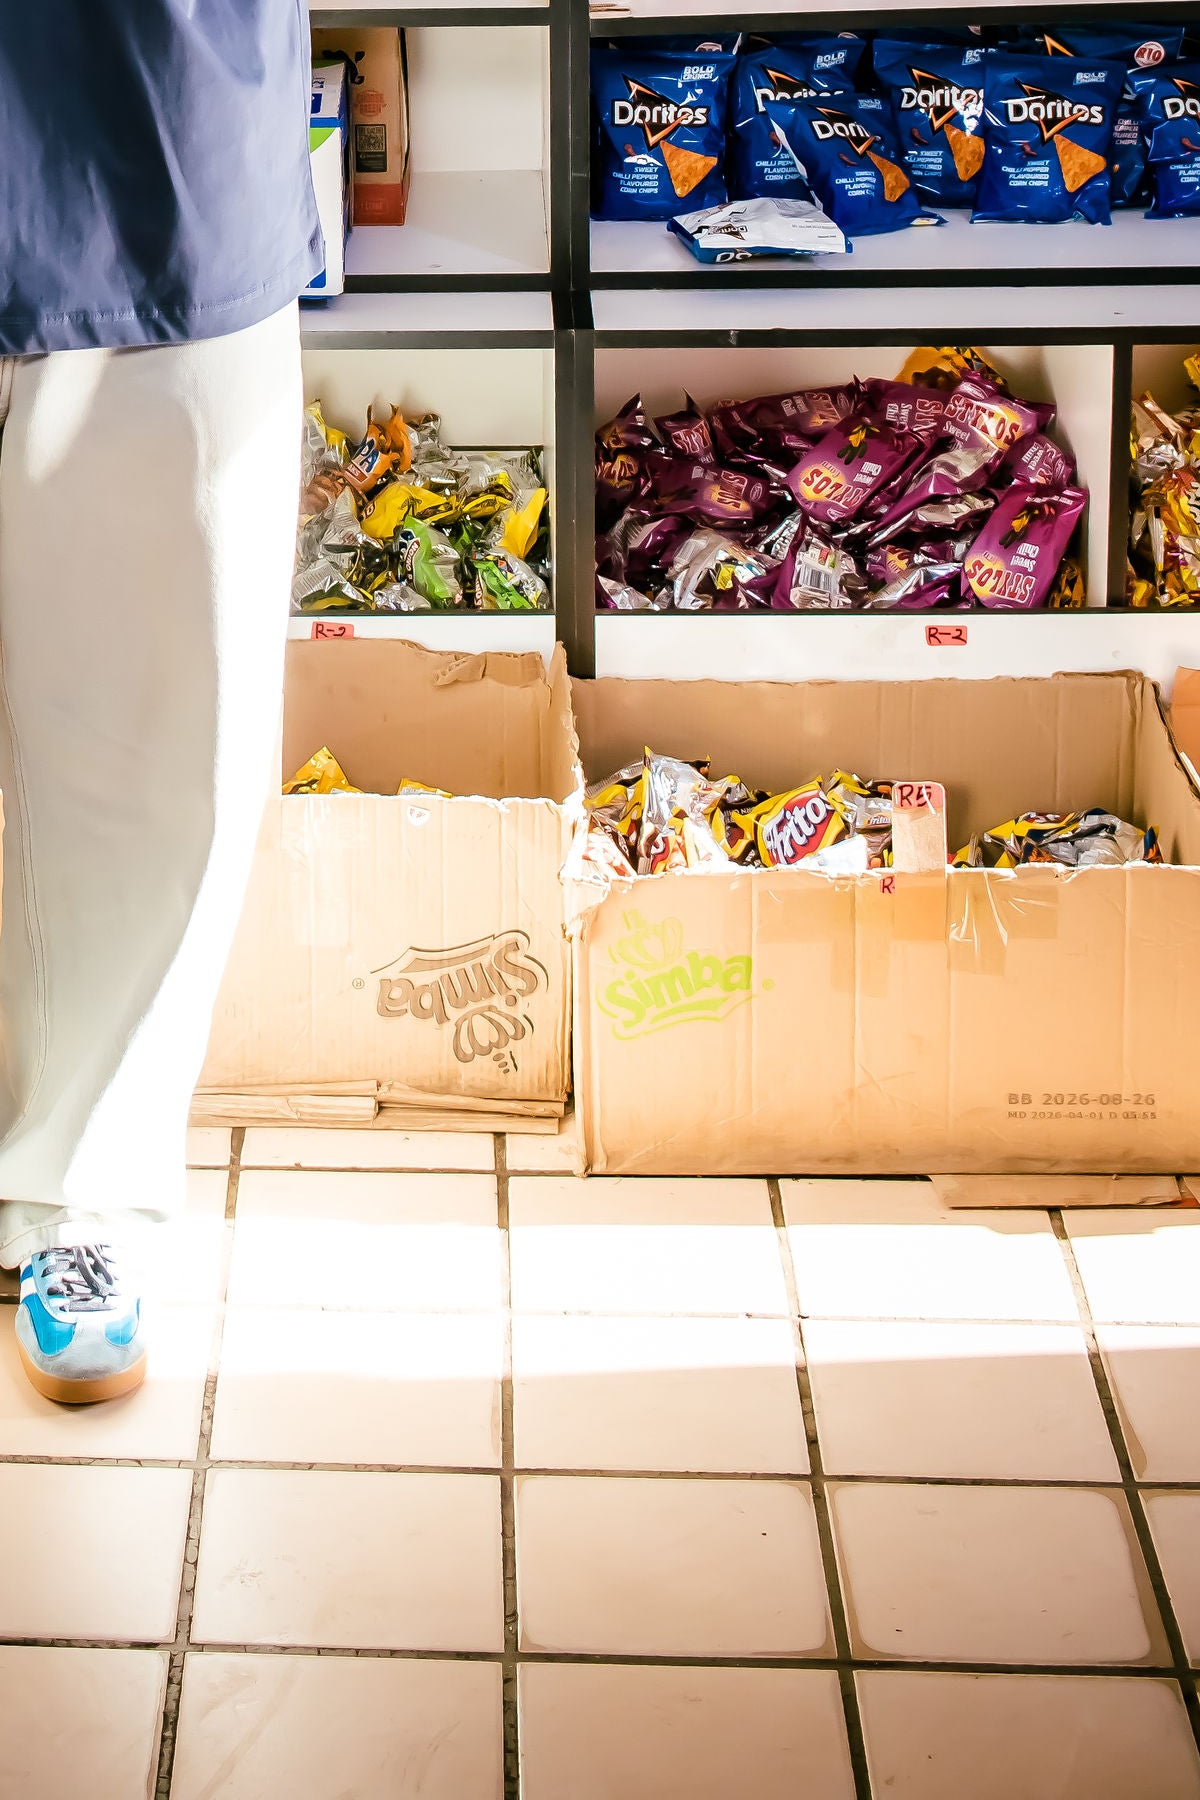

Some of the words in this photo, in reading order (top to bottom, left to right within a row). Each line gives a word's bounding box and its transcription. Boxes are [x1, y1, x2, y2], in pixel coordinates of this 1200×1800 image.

[683, 65, 714, 75] BOLD
[613, 99, 708, 126] Doritos
[1007, 99, 1103, 124] Doritos
[927, 626, 966, 645] R-2
[898, 784, 933, 808] R5
[1007, 1092, 1033, 1106] BB
[1041, 1092, 1156, 1106] 2026-08-26
[1007, 1110, 1027, 1120] MD
